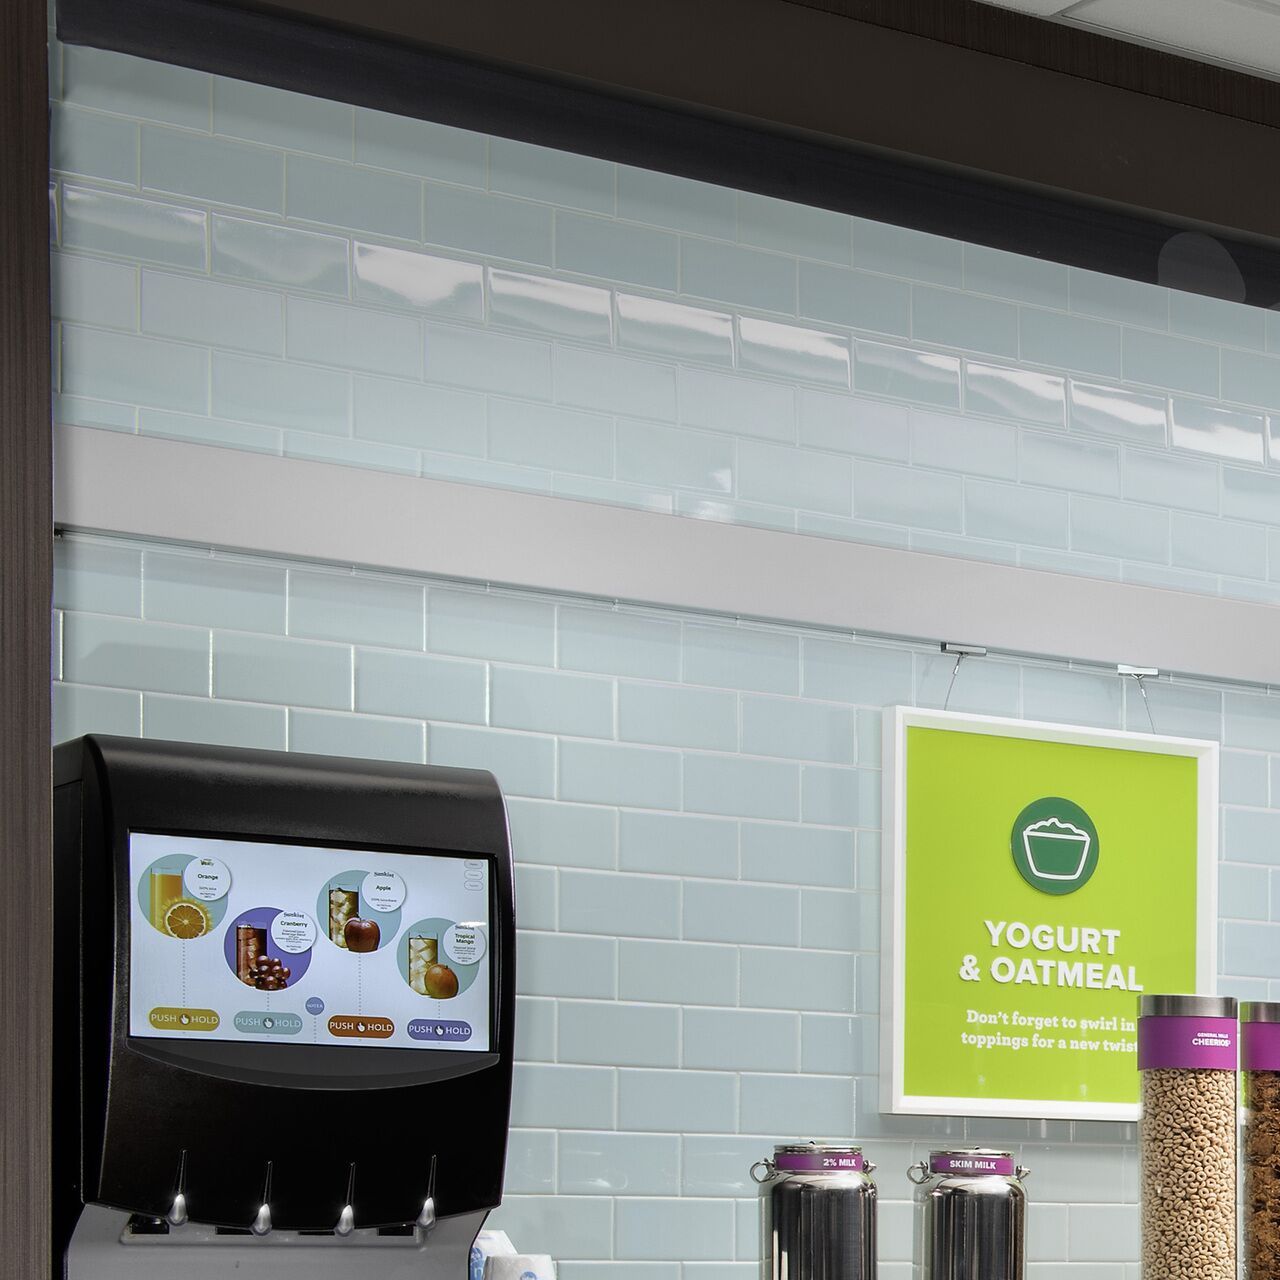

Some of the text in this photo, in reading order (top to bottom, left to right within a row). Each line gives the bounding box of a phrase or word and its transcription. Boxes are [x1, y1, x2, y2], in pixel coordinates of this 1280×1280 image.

[280, 920, 308, 928] Cranberry
[985, 920, 1121, 955] YOGURT
[959, 954, 1144, 992] & OATMEAL
[151, 1013, 218, 1024] PUSH HOLD
[235, 1017, 302, 1028] PUSH HOLD
[966, 1009, 1136, 1032] Don't forget to swirl in
[330, 1021, 393, 1032] PUSH HOLD
[408, 1024, 470, 1035] PUSH HOLD
[961, 1031, 1029, 1050] toppings
[1032, 1033, 1055, 1048] for
[1058, 1038, 1067, 1049] a
[1070, 1038, 1101, 1050] new
[823, 1158, 856, 1168] 2% MILK
[950, 1159, 996, 1170] SKIM MILK
